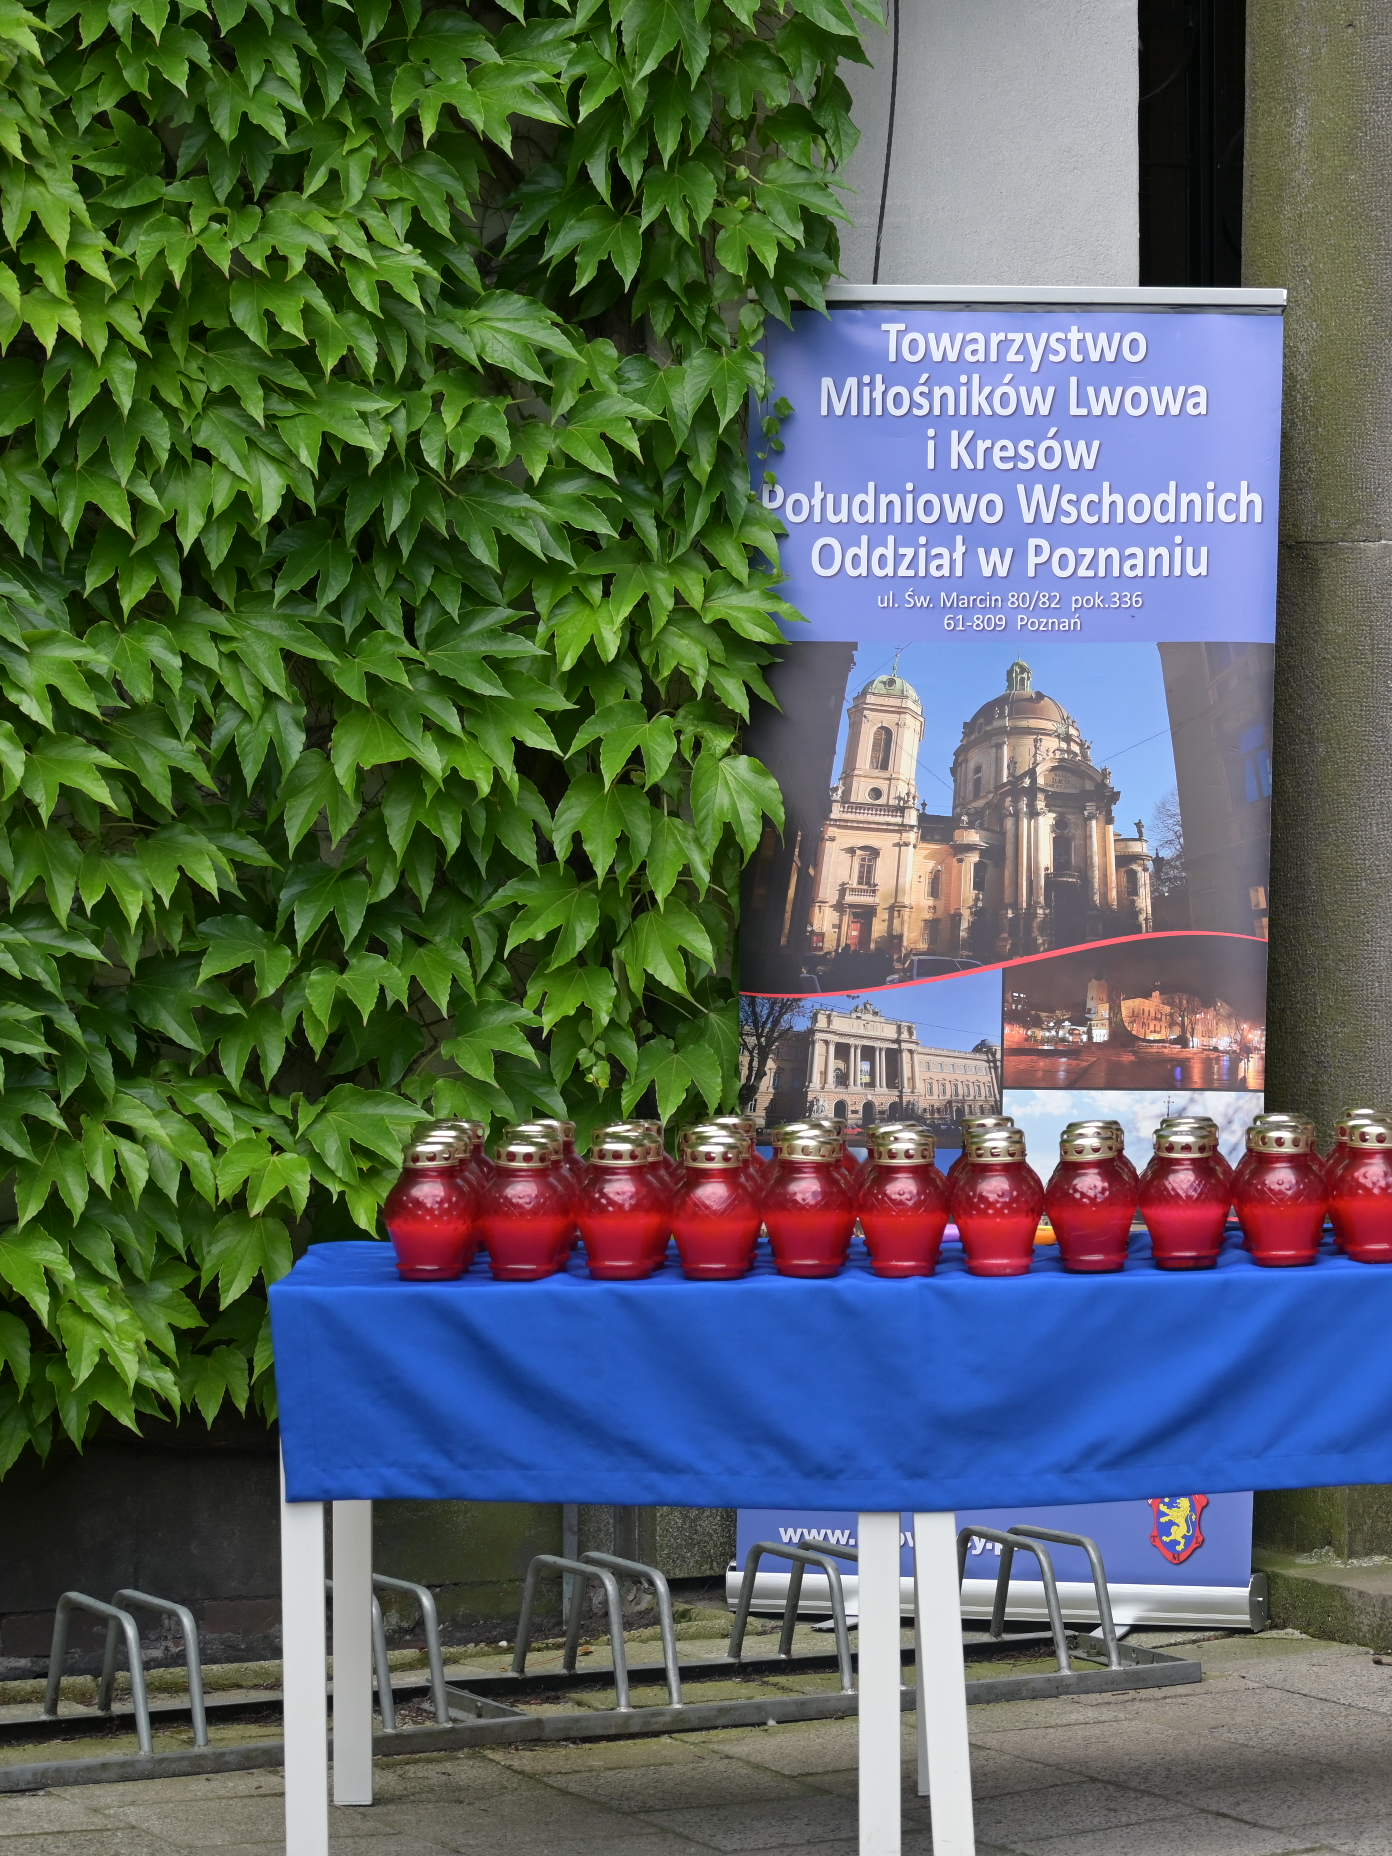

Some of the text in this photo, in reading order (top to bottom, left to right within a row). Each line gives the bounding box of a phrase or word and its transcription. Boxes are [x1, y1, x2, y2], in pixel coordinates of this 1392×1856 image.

[881, 323, 1148, 373] Towarzystwo
[820, 373, 1208, 417] Miłośników Lwowa
[927, 427, 1100, 470] i Kresów
[762, 480, 1264, 524] Południowo Wschodnich
[811, 535, 1209, 578] Oddział w Poznaniu
[878, 588, 1143, 612] ul. Św. Marcin 80/82 pok.336
[943, 613, 1081, 631] 61-809 Poznań
